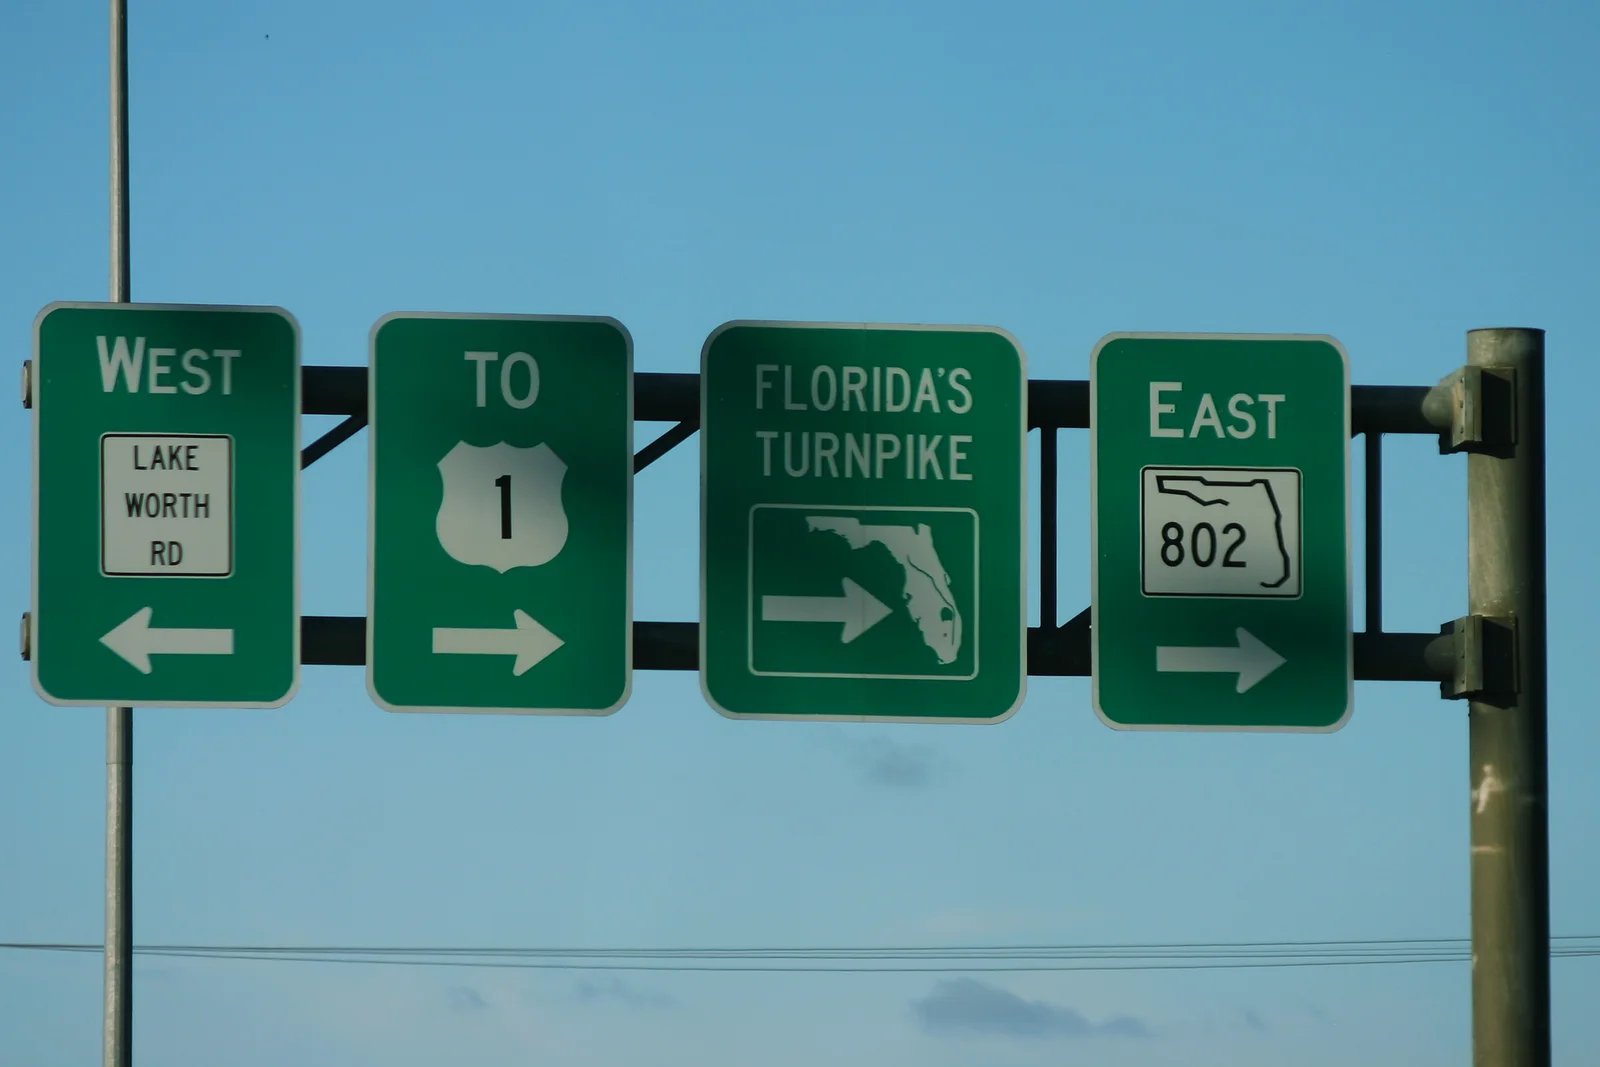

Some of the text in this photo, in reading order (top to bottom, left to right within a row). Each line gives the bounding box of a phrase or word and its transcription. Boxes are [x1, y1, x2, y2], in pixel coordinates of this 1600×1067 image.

[96, 336, 242, 397] WEST
[464, 351, 541, 409] TO
[755, 364, 973, 414] FLORIDA'S
[1149, 381, 1286, 440] EAST
[134, 445, 199, 471] LAKE
[756, 431, 973, 481] TURNPIKE
[125, 492, 210, 519] WORTH
[495, 474, 513, 540] 1
[150, 540, 184, 566] RD
[1160, 522, 1247, 568] 802
